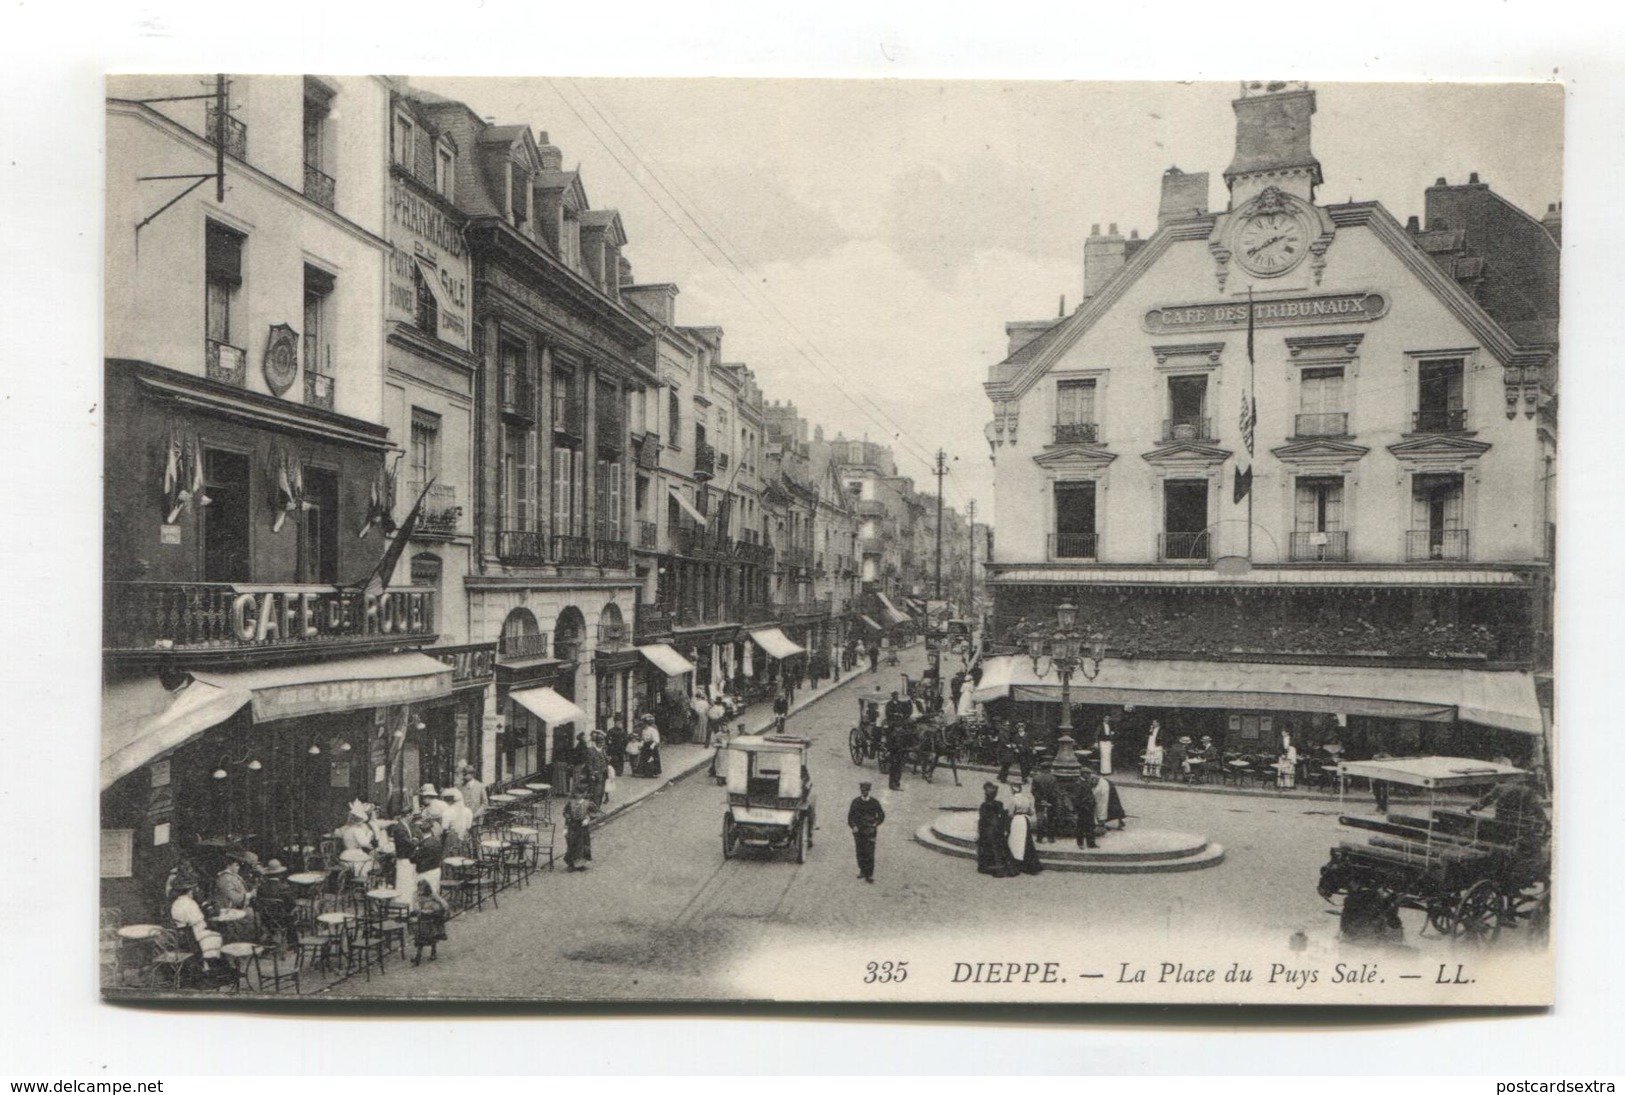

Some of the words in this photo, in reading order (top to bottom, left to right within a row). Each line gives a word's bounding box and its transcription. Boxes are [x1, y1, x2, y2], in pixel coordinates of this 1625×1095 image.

[1214, 306, 1248, 321] DES
[1254, 298, 1365, 319] TRIBUNAUX
[863, 961, 909, 984] 335
[951, 962, 1067, 984] DIEPPE.
[1116, 962, 1145, 984] La
[1158, 963, 1216, 984] Place
[1224, 963, 1253, 984] du
[1268, 963, 1319, 990] Puys
[1331, 963, 1385, 984] Salé.
[1435, 963, 1476, 985] LL.
